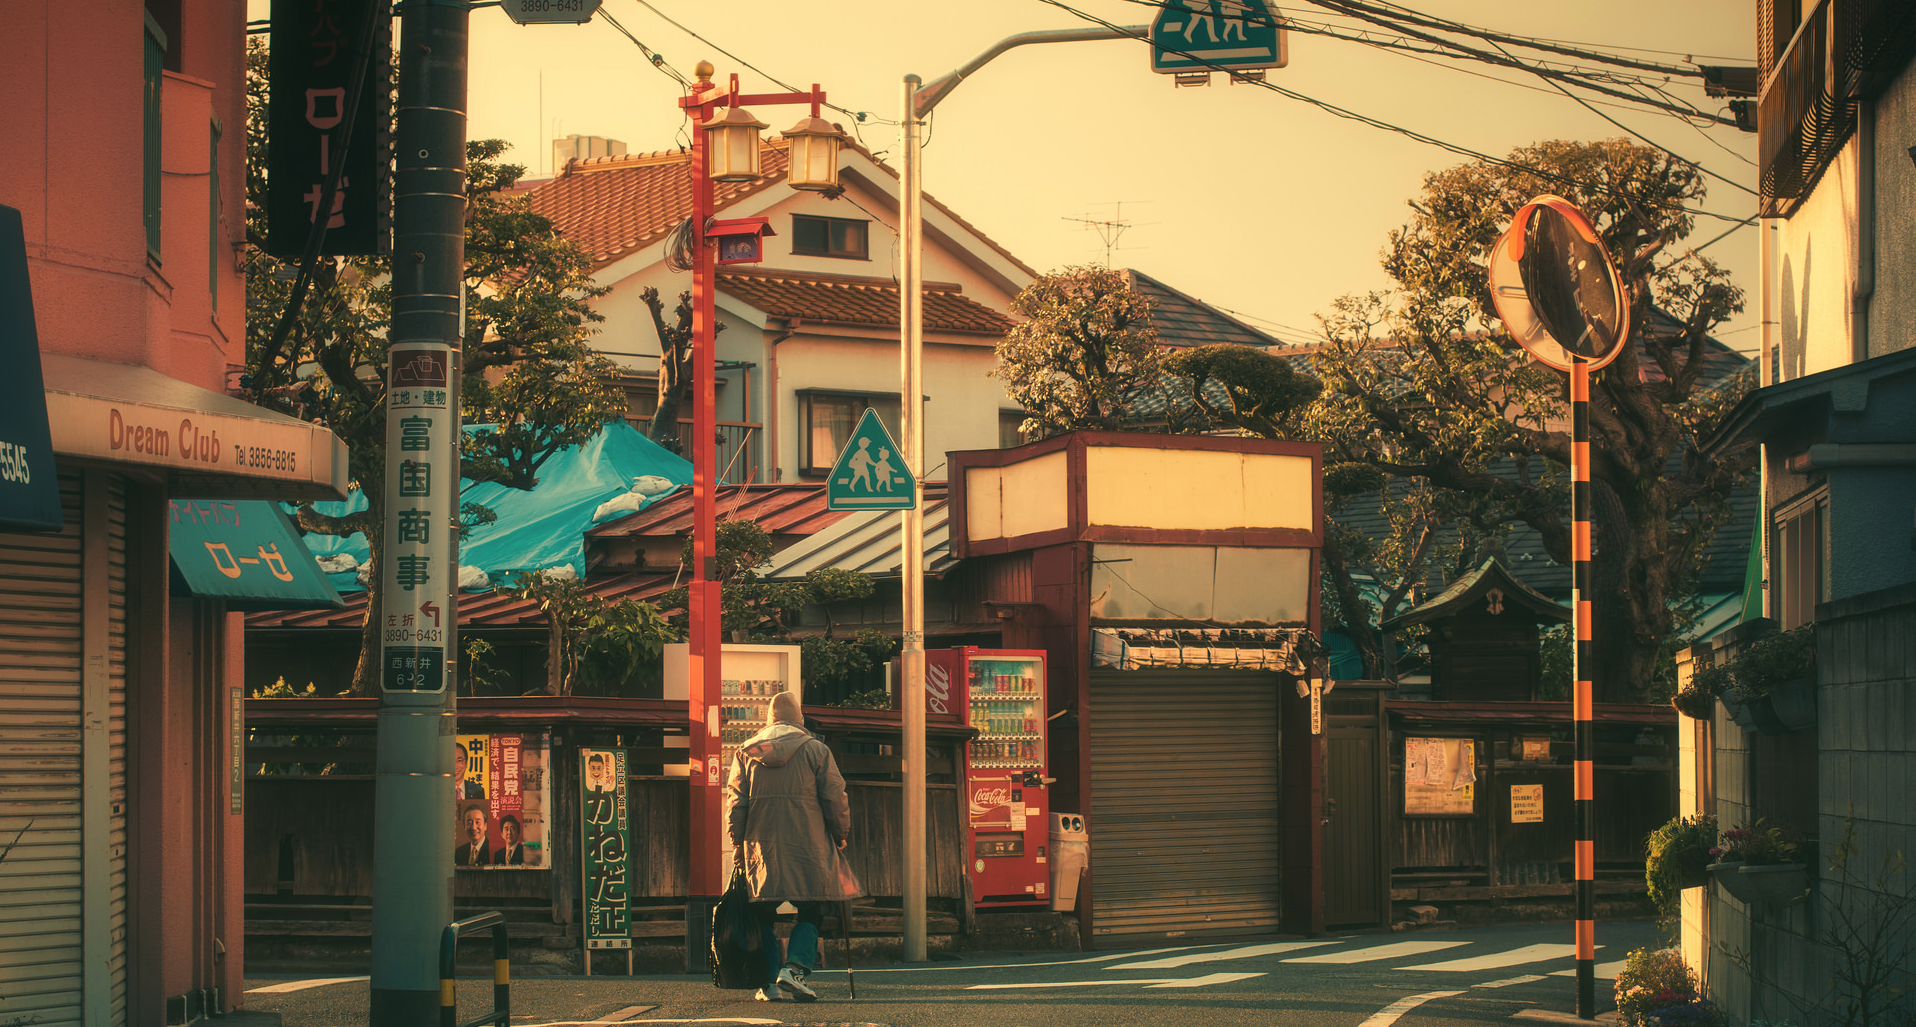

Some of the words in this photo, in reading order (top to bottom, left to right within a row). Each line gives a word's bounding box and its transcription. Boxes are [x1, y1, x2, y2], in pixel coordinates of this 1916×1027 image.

[520, 0, 583, 12] 3890-6431
[391, 390, 447, 406] 土地・建物
[109, 408, 169, 458] Dream
[178, 418, 221, 464] Club
[249, 446, 296, 473] 3856-8815
[396, 414, 433, 591] 富国商事
[204, 541, 294, 582] ローゼ
[387, 613, 415, 627] 左折
[384, 628, 442, 642] 3890-6431
[391, 656, 432, 669] 西新井
[469, 738, 483, 773] 中川
[490, 738, 500, 820] 経済で、結果を出す。
[503, 746, 519, 796] 自民党
[500, 795, 523, 805] 演説会
[615, 752, 628, 831] 足立区議会議員
[973, 787, 1008, 806] Coca-Cola
